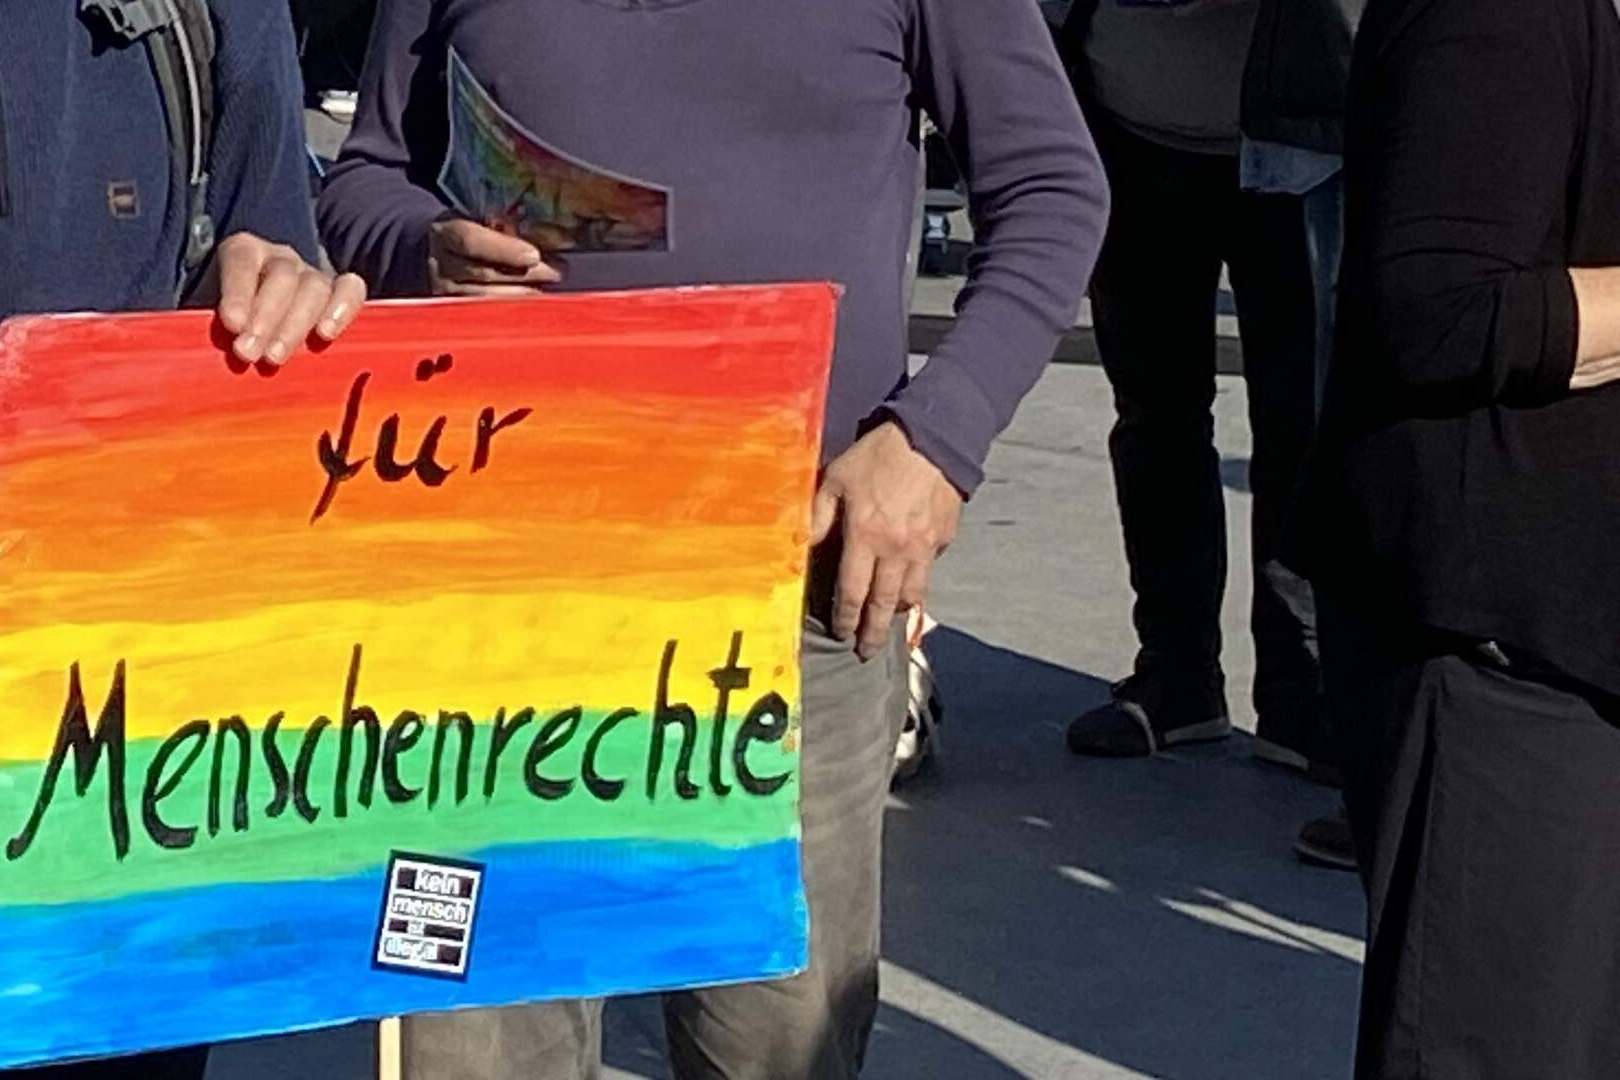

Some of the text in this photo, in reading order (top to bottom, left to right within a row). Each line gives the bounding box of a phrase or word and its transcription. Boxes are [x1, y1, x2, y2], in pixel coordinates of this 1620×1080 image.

[312, 353, 532, 524] für
[6, 631, 793, 862] Menschenrechte
[392, 894, 468, 923] mensch
[413, 869, 460, 895] kein
